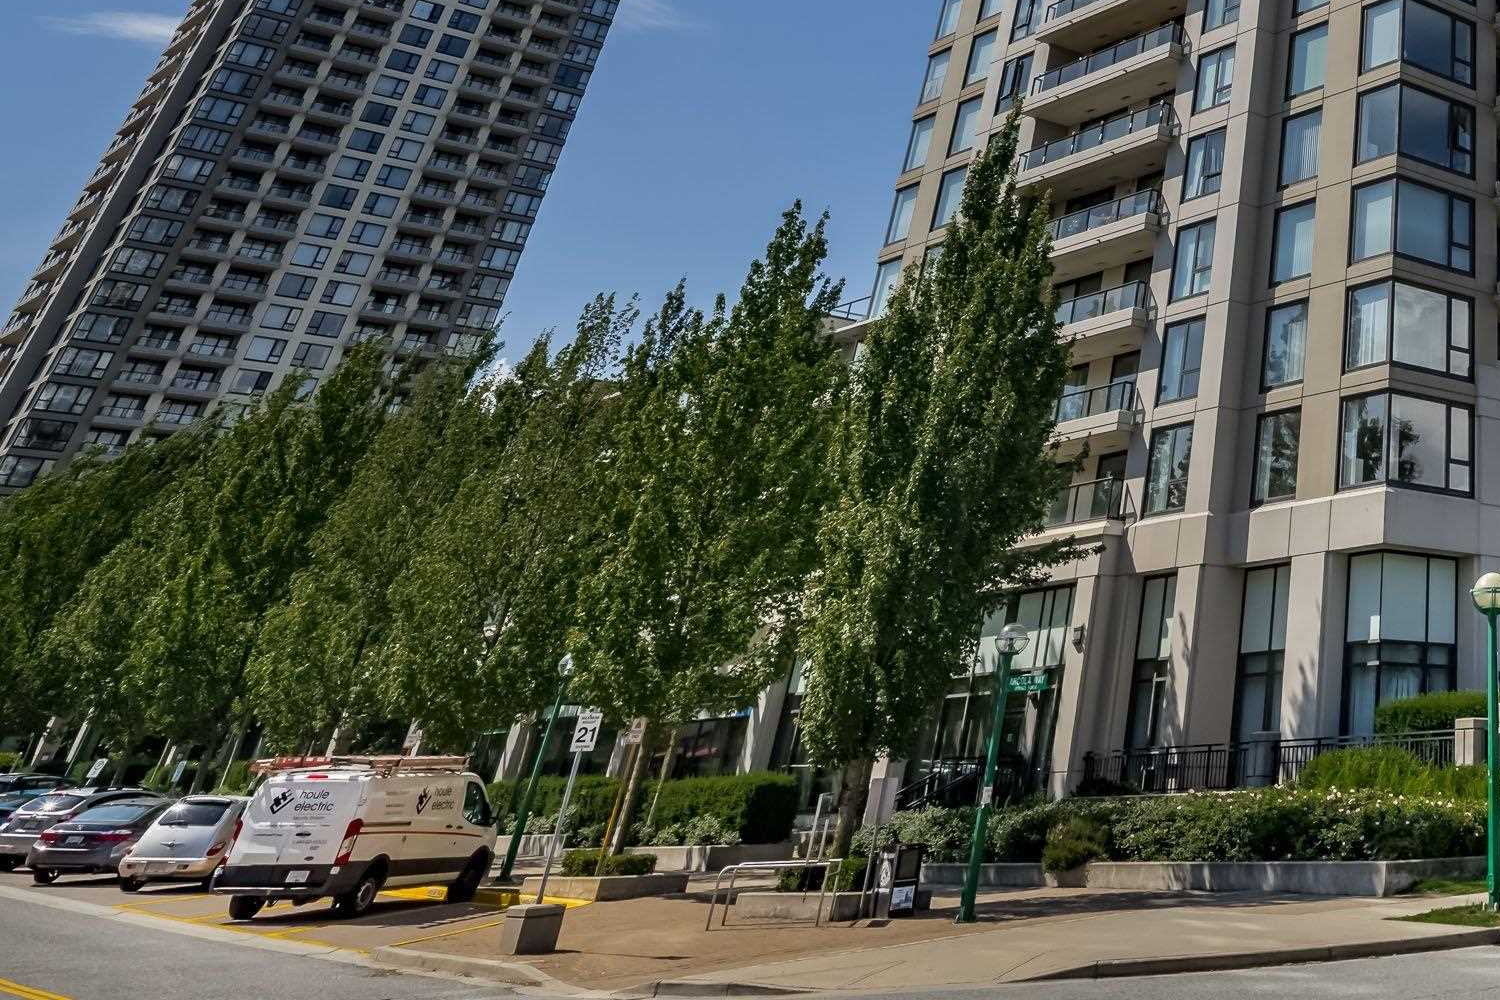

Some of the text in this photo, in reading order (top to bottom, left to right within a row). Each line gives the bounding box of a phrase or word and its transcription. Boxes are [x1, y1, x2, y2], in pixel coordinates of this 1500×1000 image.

[575, 727, 597, 743] 21
[300, 788, 330, 800] houle
[294, 802, 334, 812] electric
